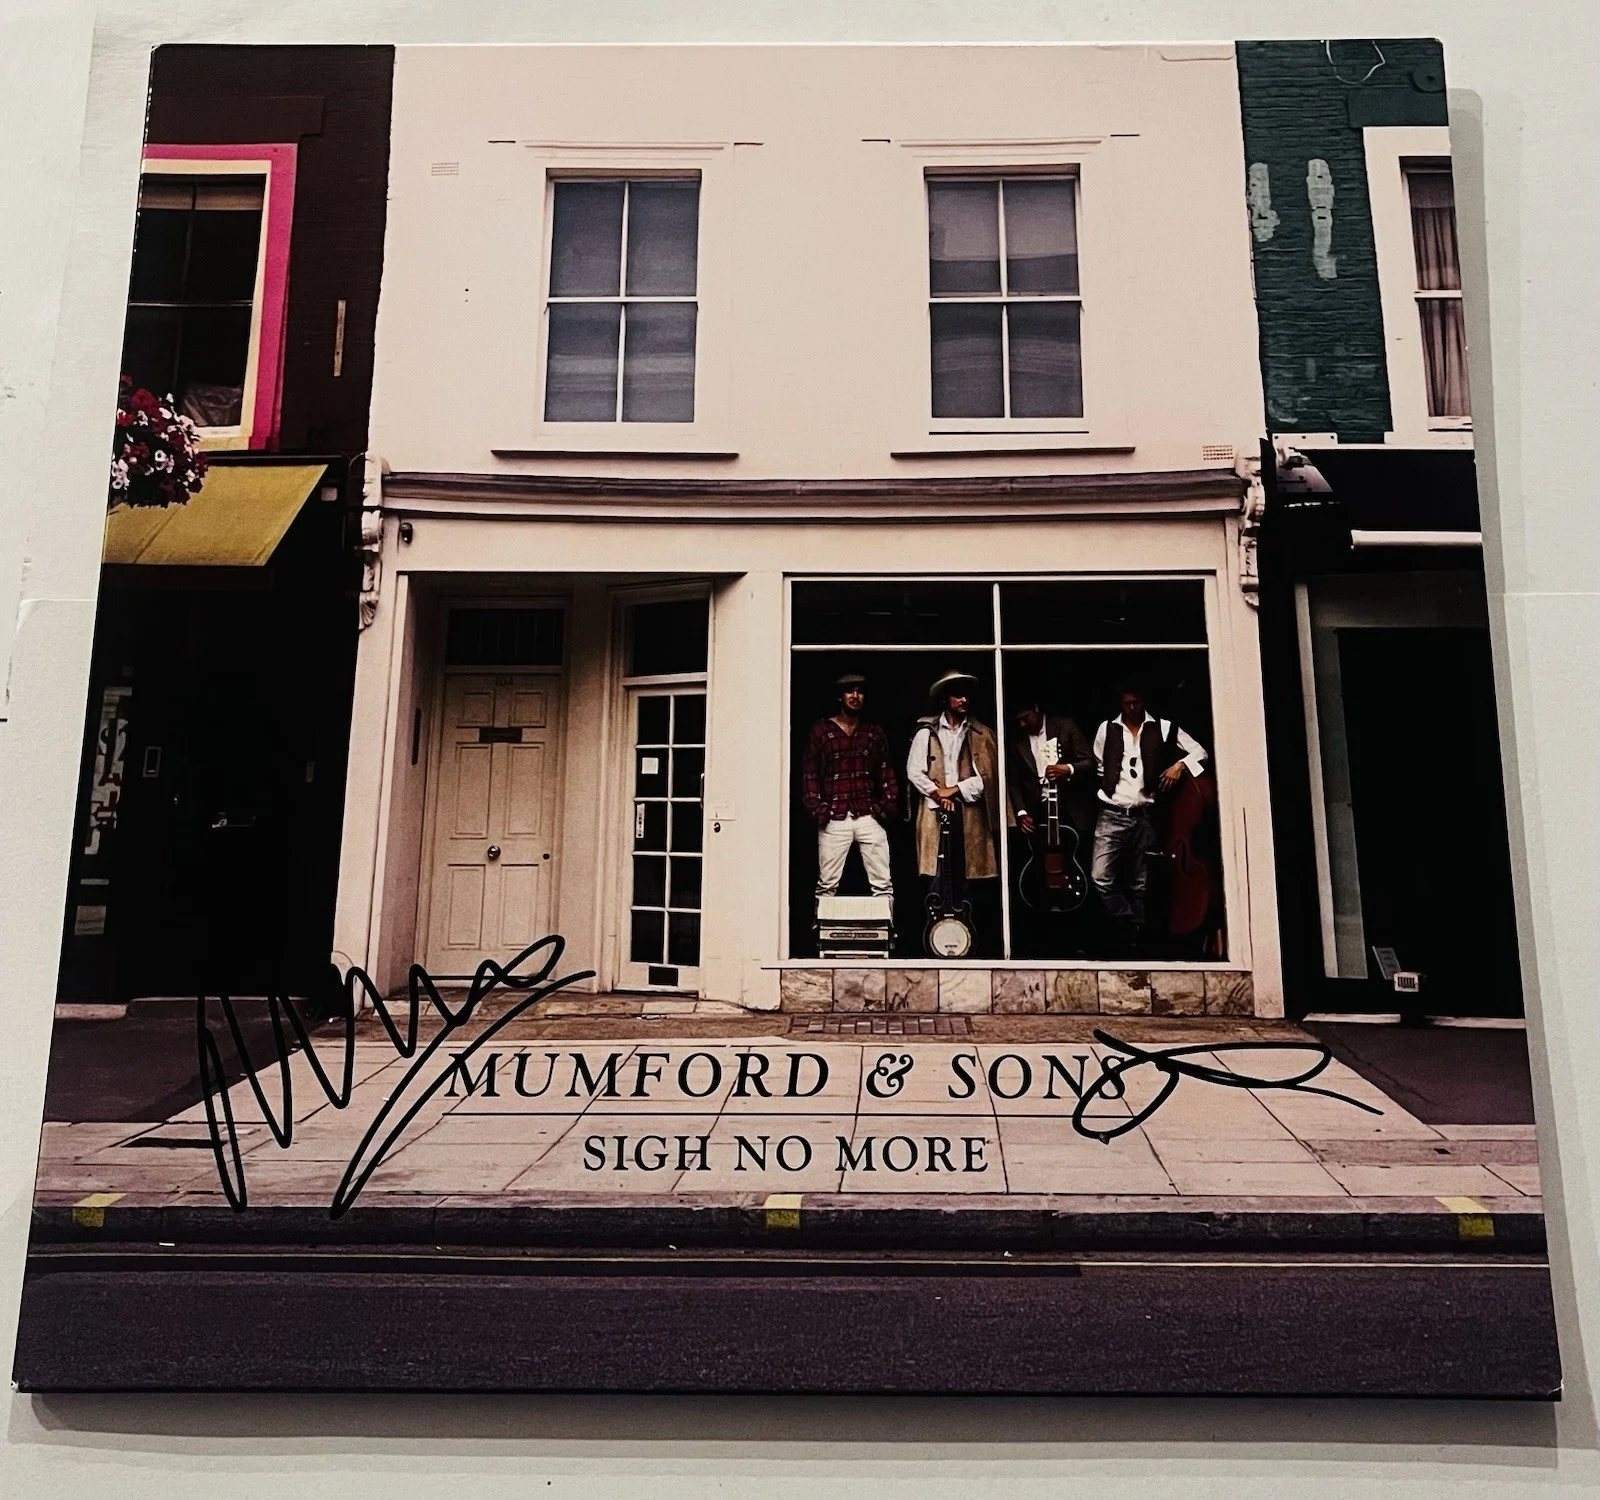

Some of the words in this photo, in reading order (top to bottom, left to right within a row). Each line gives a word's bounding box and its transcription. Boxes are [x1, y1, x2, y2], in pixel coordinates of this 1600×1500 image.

[444, 1053, 829, 1098] MUMFORD
[866, 1053, 914, 1098] &
[948, 1053, 1126, 1099] SONS
[583, 1135, 711, 1171] SIGH
[734, 1135, 812, 1172] NO
[835, 1135, 988, 1172] MORE
